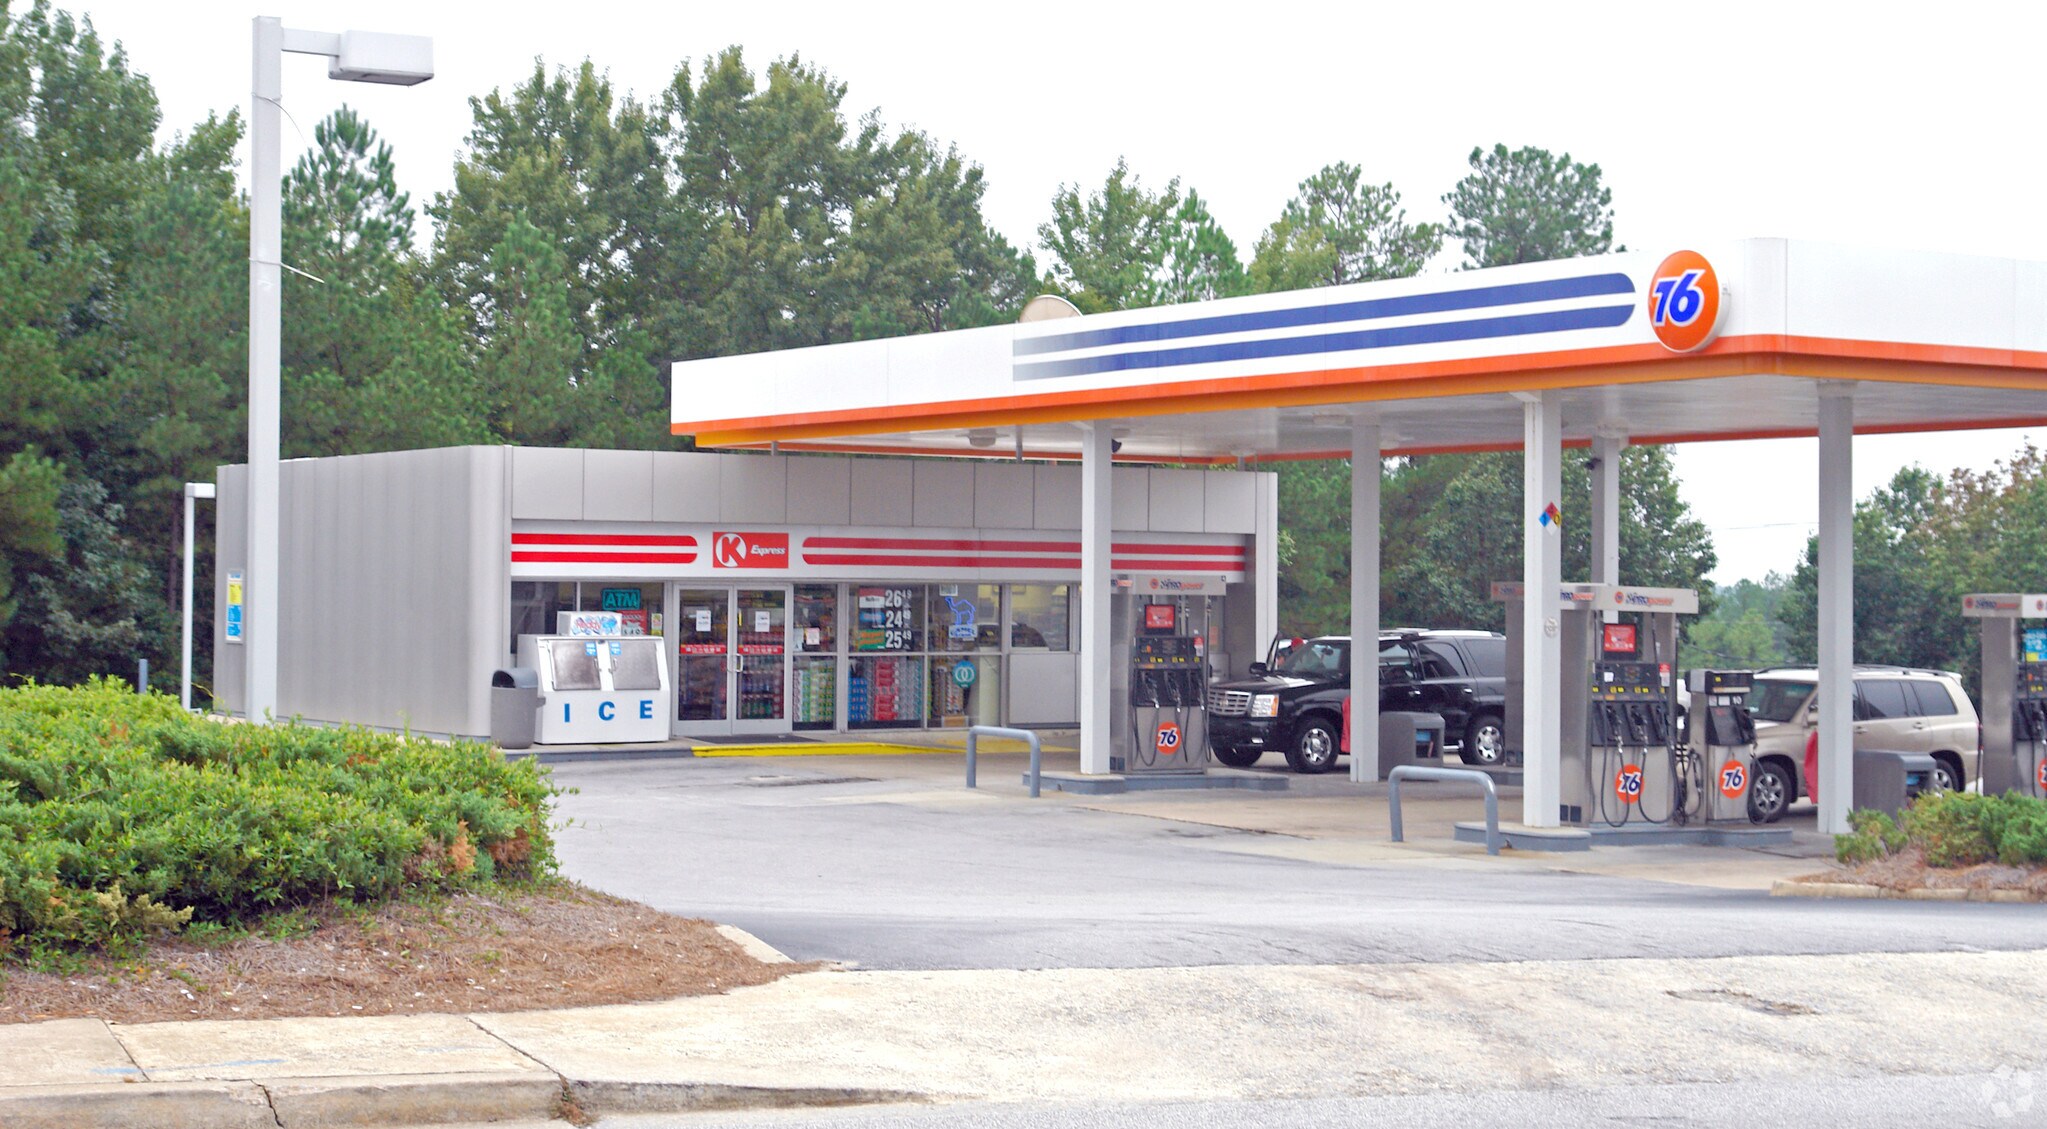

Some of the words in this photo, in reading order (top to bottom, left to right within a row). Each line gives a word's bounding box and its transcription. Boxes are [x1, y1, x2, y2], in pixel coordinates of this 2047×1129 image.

[1652, 269, 1706, 327] 76
[720, 535, 745, 567] K
[751, 545, 786, 556] Express
[605, 592, 638, 609] ATM
[564, 700, 653, 723] ICE
[1158, 728, 1178, 747] 76
[1618, 771, 1642, 795] 76
[1722, 766, 1743, 791] 76
